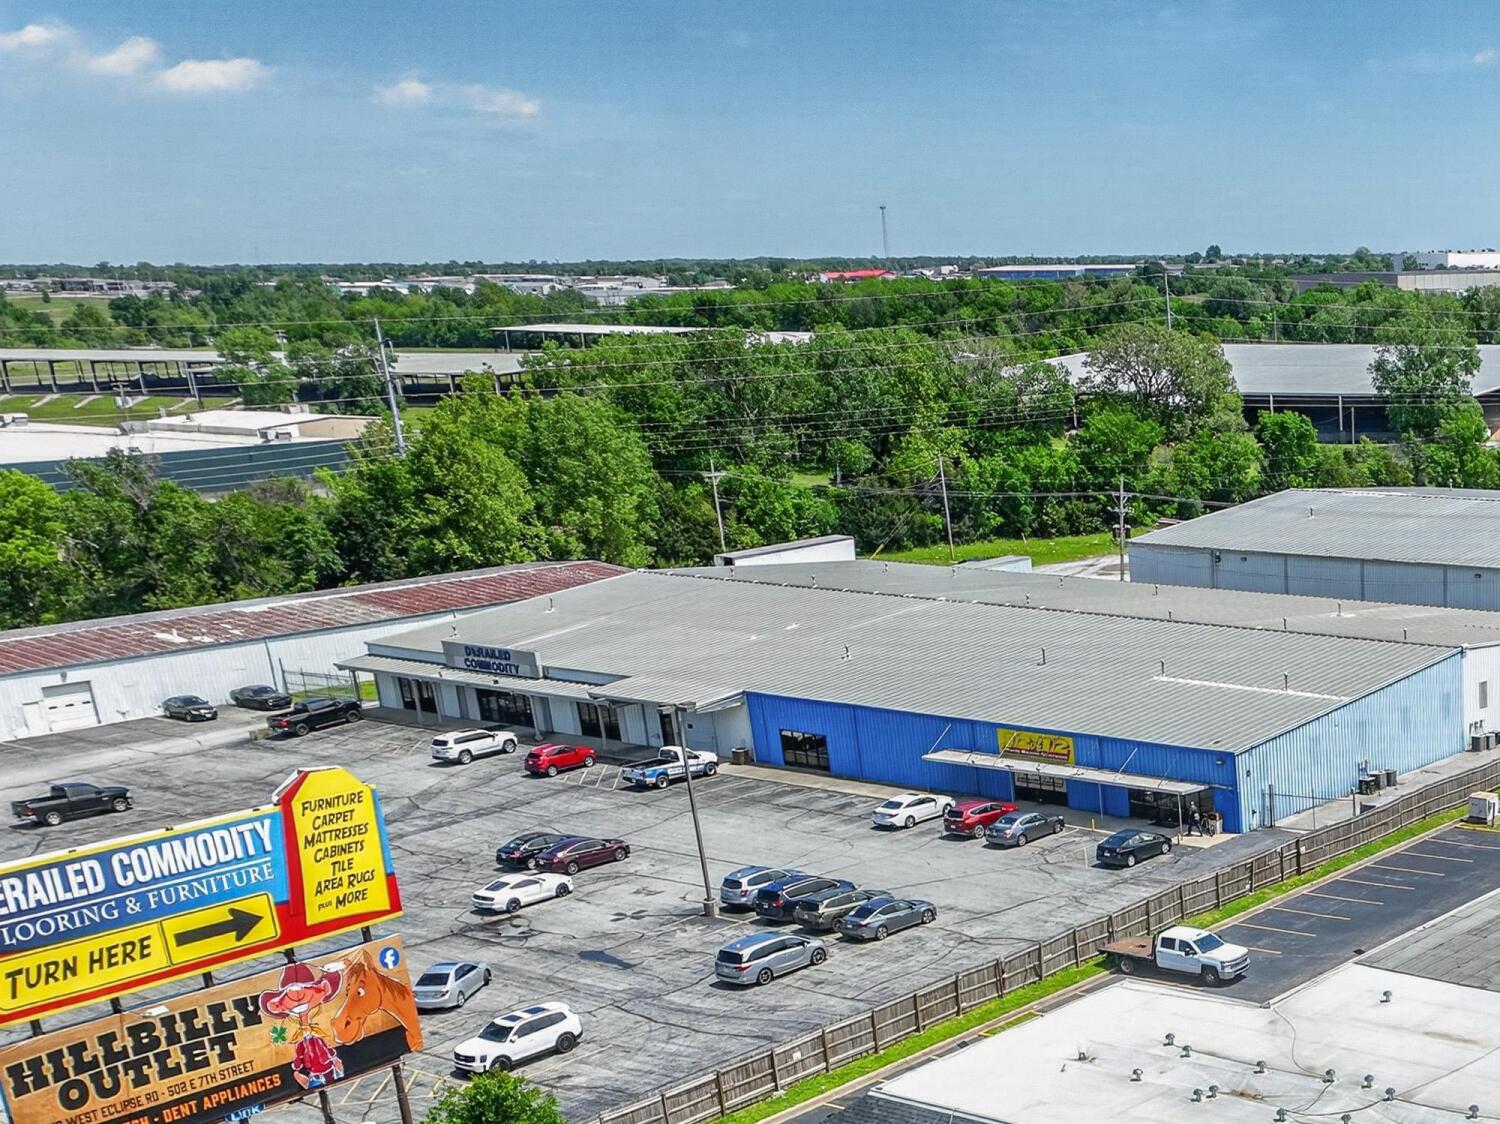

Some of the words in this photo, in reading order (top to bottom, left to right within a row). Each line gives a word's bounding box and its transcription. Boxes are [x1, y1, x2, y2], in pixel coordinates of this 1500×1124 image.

[301, 790, 364, 817] FURNITURE
[312, 808, 355, 831] CARPET
[111, 818, 273, 887] COMMODITY
[304, 822, 369, 850] MATTRESSES
[313, 839, 365, 863] CABINETS
[314, 876, 344, 897] AREA
[347, 869, 376, 889] RUGS
[330, 857, 354, 876] TILE
[0, 901, 119, 946] LOORING
[125, 897, 142, 915] &
[147, 862, 274, 909] FURNITURE
[335, 888, 368, 909] MORE
[5, 955, 78, 1000] TURN
[88, 935, 152, 974] HERE
[5, 994, 263, 1098] HILLBILLY
[58, 1032, 237, 1111] OUTLET
[101, 1096, 144, 1118] ECLIPSE
[145, 1090, 160, 1105] RD
[167, 1082, 188, 1097] 502
[190, 1078, 197, 1090] E
[199, 1072, 218, 1088] 7TH
[220, 1060, 255, 1081] STREET
[162, 1100, 199, 1123] DENT
[203, 1073, 283, 1111] APPLIANCES
